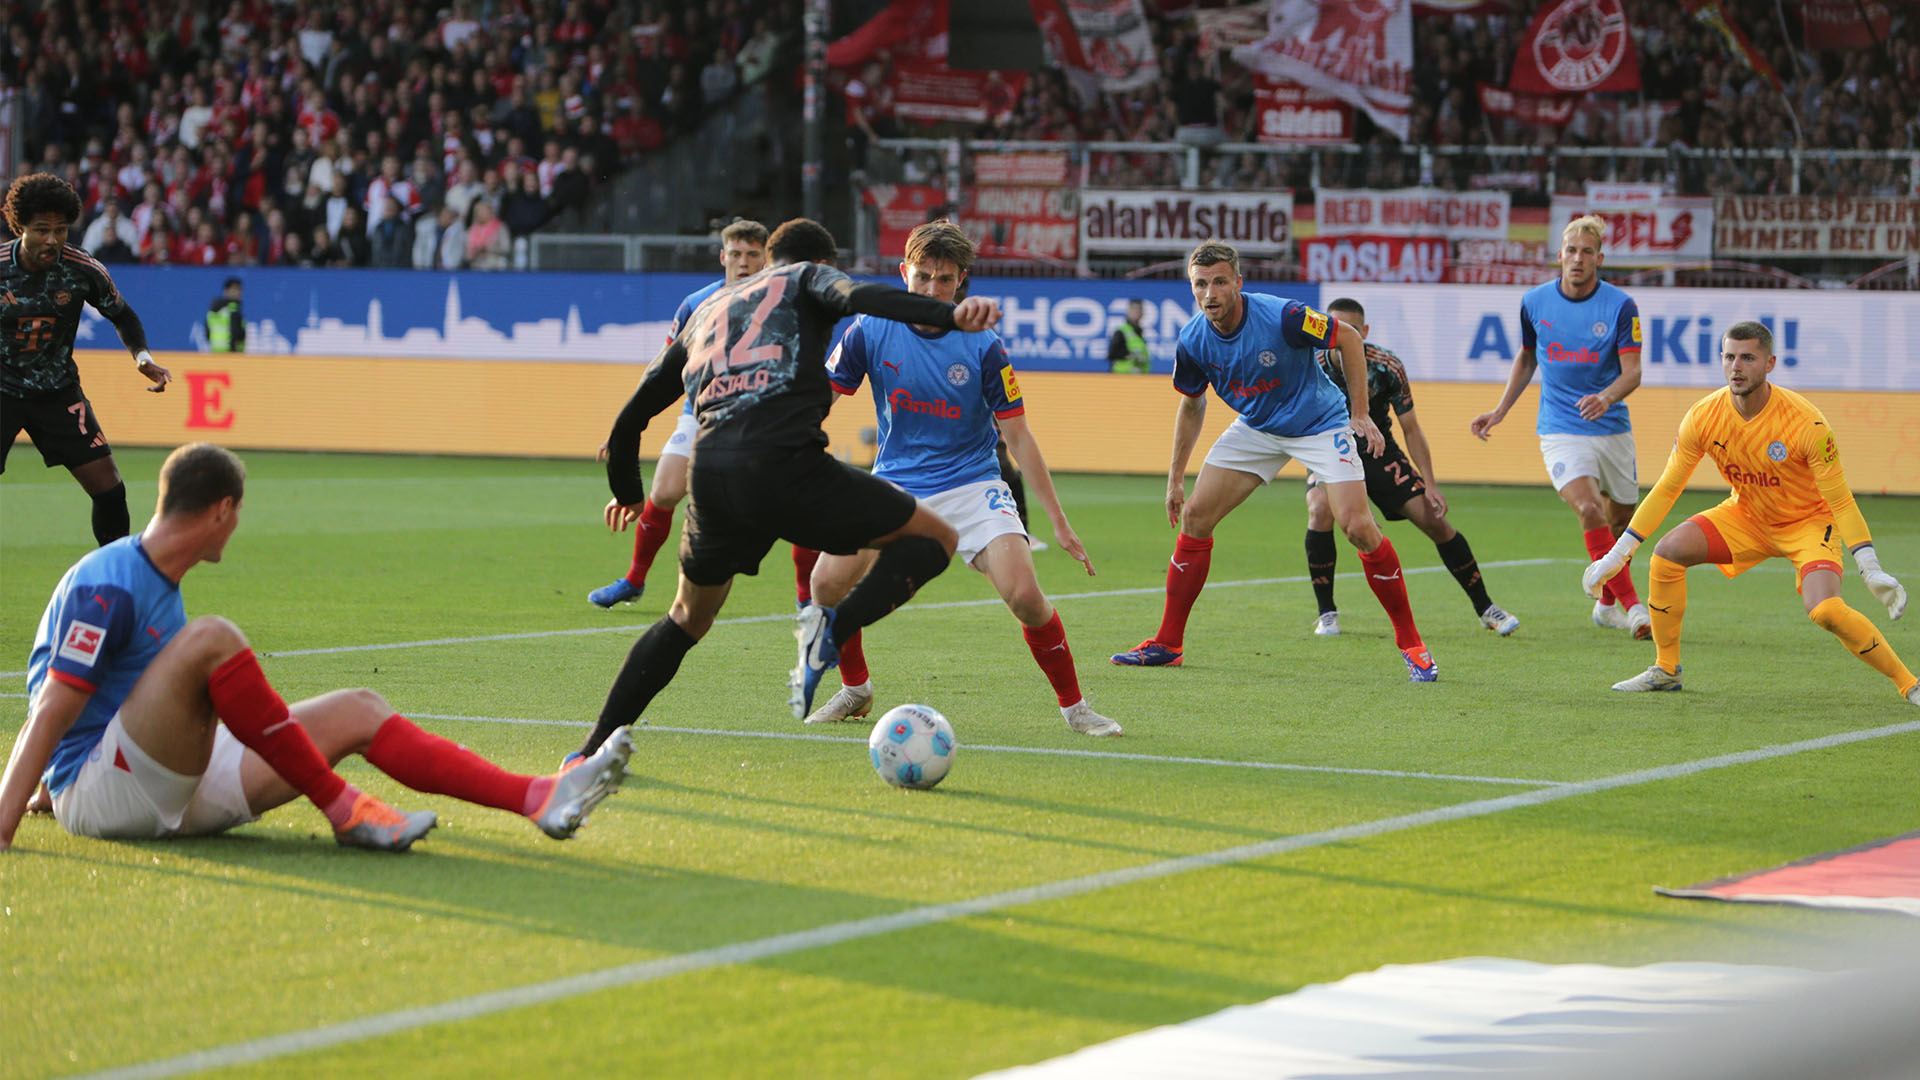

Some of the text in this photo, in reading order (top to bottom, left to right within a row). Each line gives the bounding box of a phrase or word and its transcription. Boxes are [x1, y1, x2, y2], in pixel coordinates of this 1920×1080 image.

[1086, 199, 1287, 243] alarMstufe
[1323, 199, 1372, 225] RED
[1719, 226, 1818, 251] IMMER
[1829, 227, 1876, 251] BEI
[1306, 238, 1444, 283] RÖSLAU
[687, 275, 788, 376] 42
[1547, 342, 1600, 363] famila
[185, 371, 235, 431] E
[1229, 378, 1281, 399] famila
[887, 388, 961, 419] famila
[67, 401, 88, 435] 7
[1333, 432, 1350, 455] 5
[1725, 464, 1781, 487] famila
[1823, 524, 1832, 543] 1
